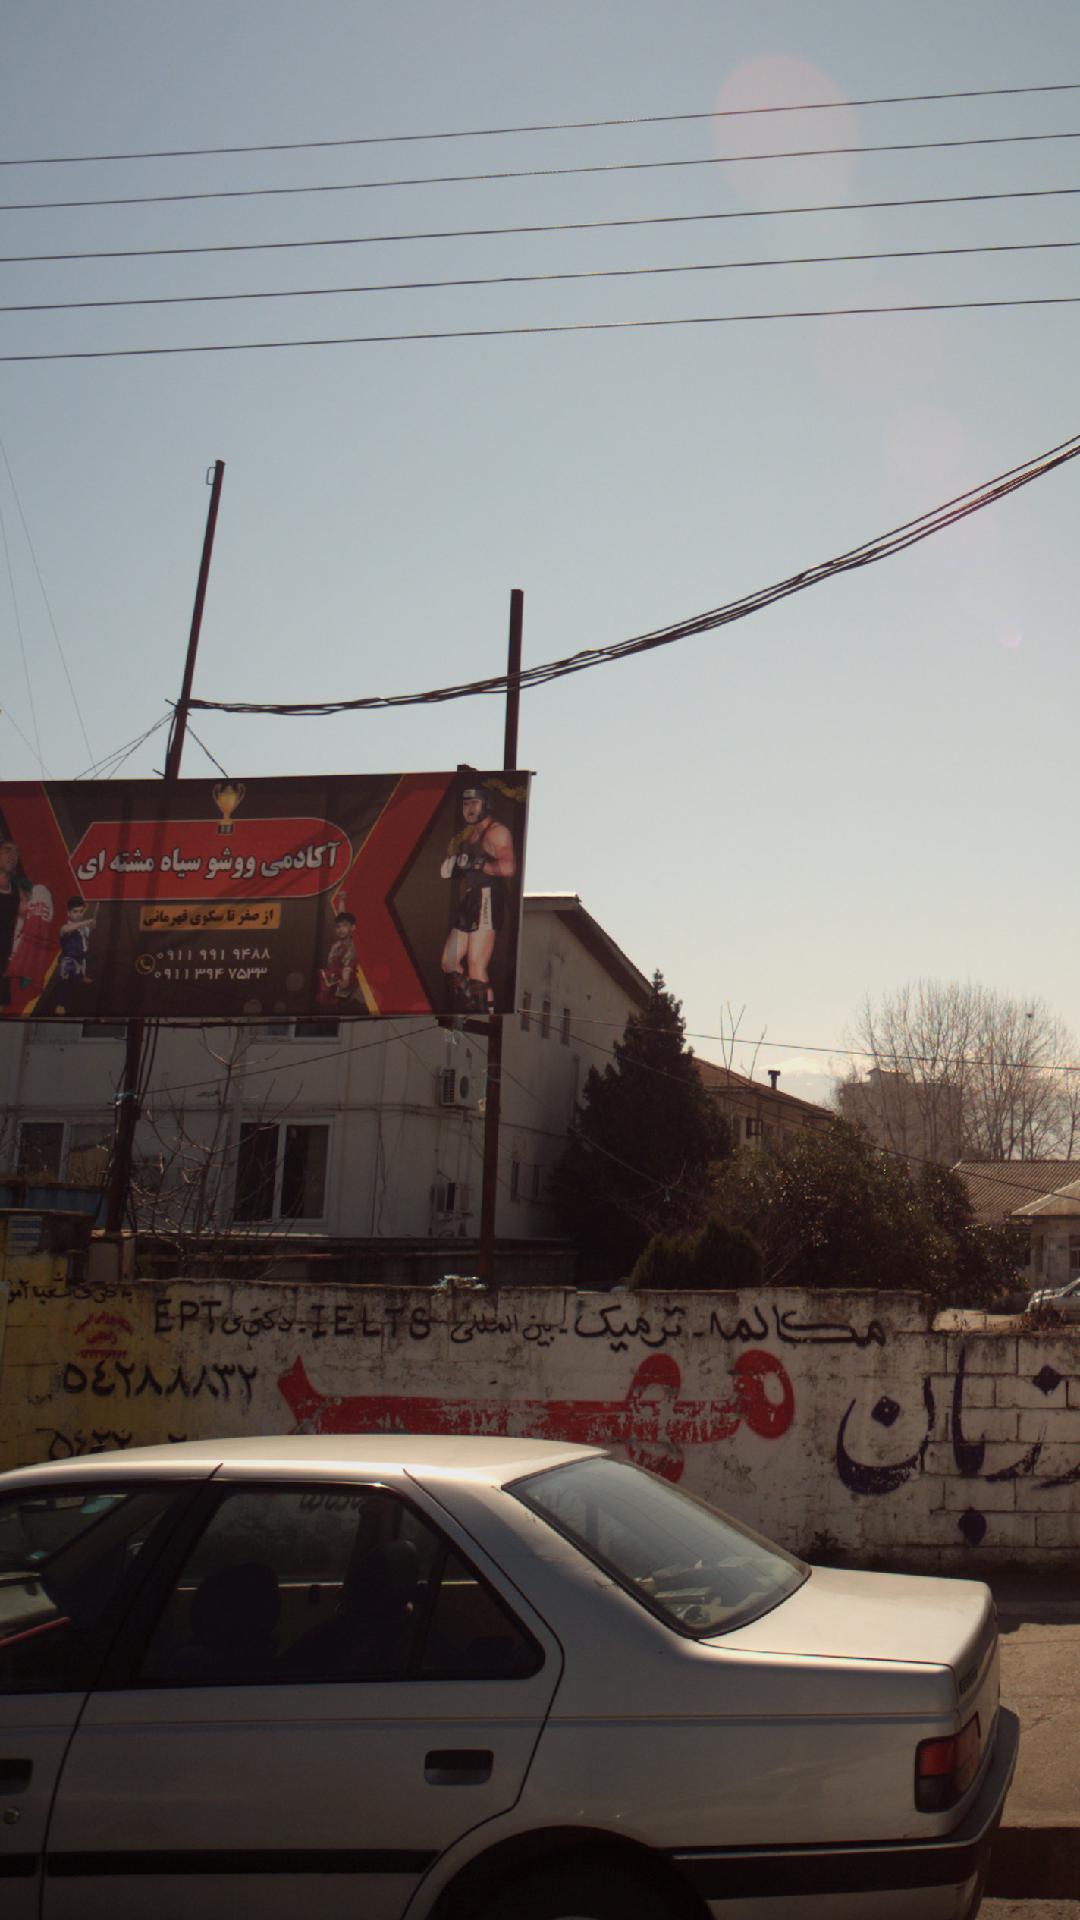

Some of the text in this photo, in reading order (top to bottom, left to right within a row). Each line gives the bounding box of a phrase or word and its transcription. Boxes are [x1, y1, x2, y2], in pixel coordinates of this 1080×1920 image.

[77, 840, 341, 880] آکادمی ووشو سیاه مشته ای
[143, 909, 273, 927] از صفر تا سکوی قهرمانی
[157, 947, 271, 961] ۰۹۱۱ ۹۹۱ ۹۴۸۸
[154, 968, 189, 980] ۰۹۱۱
[154, 1300, 222, 1334] EPT
[310, 1304, 432, 1340] IELTS
[710, 1304, 887, 1348] مکالمه
